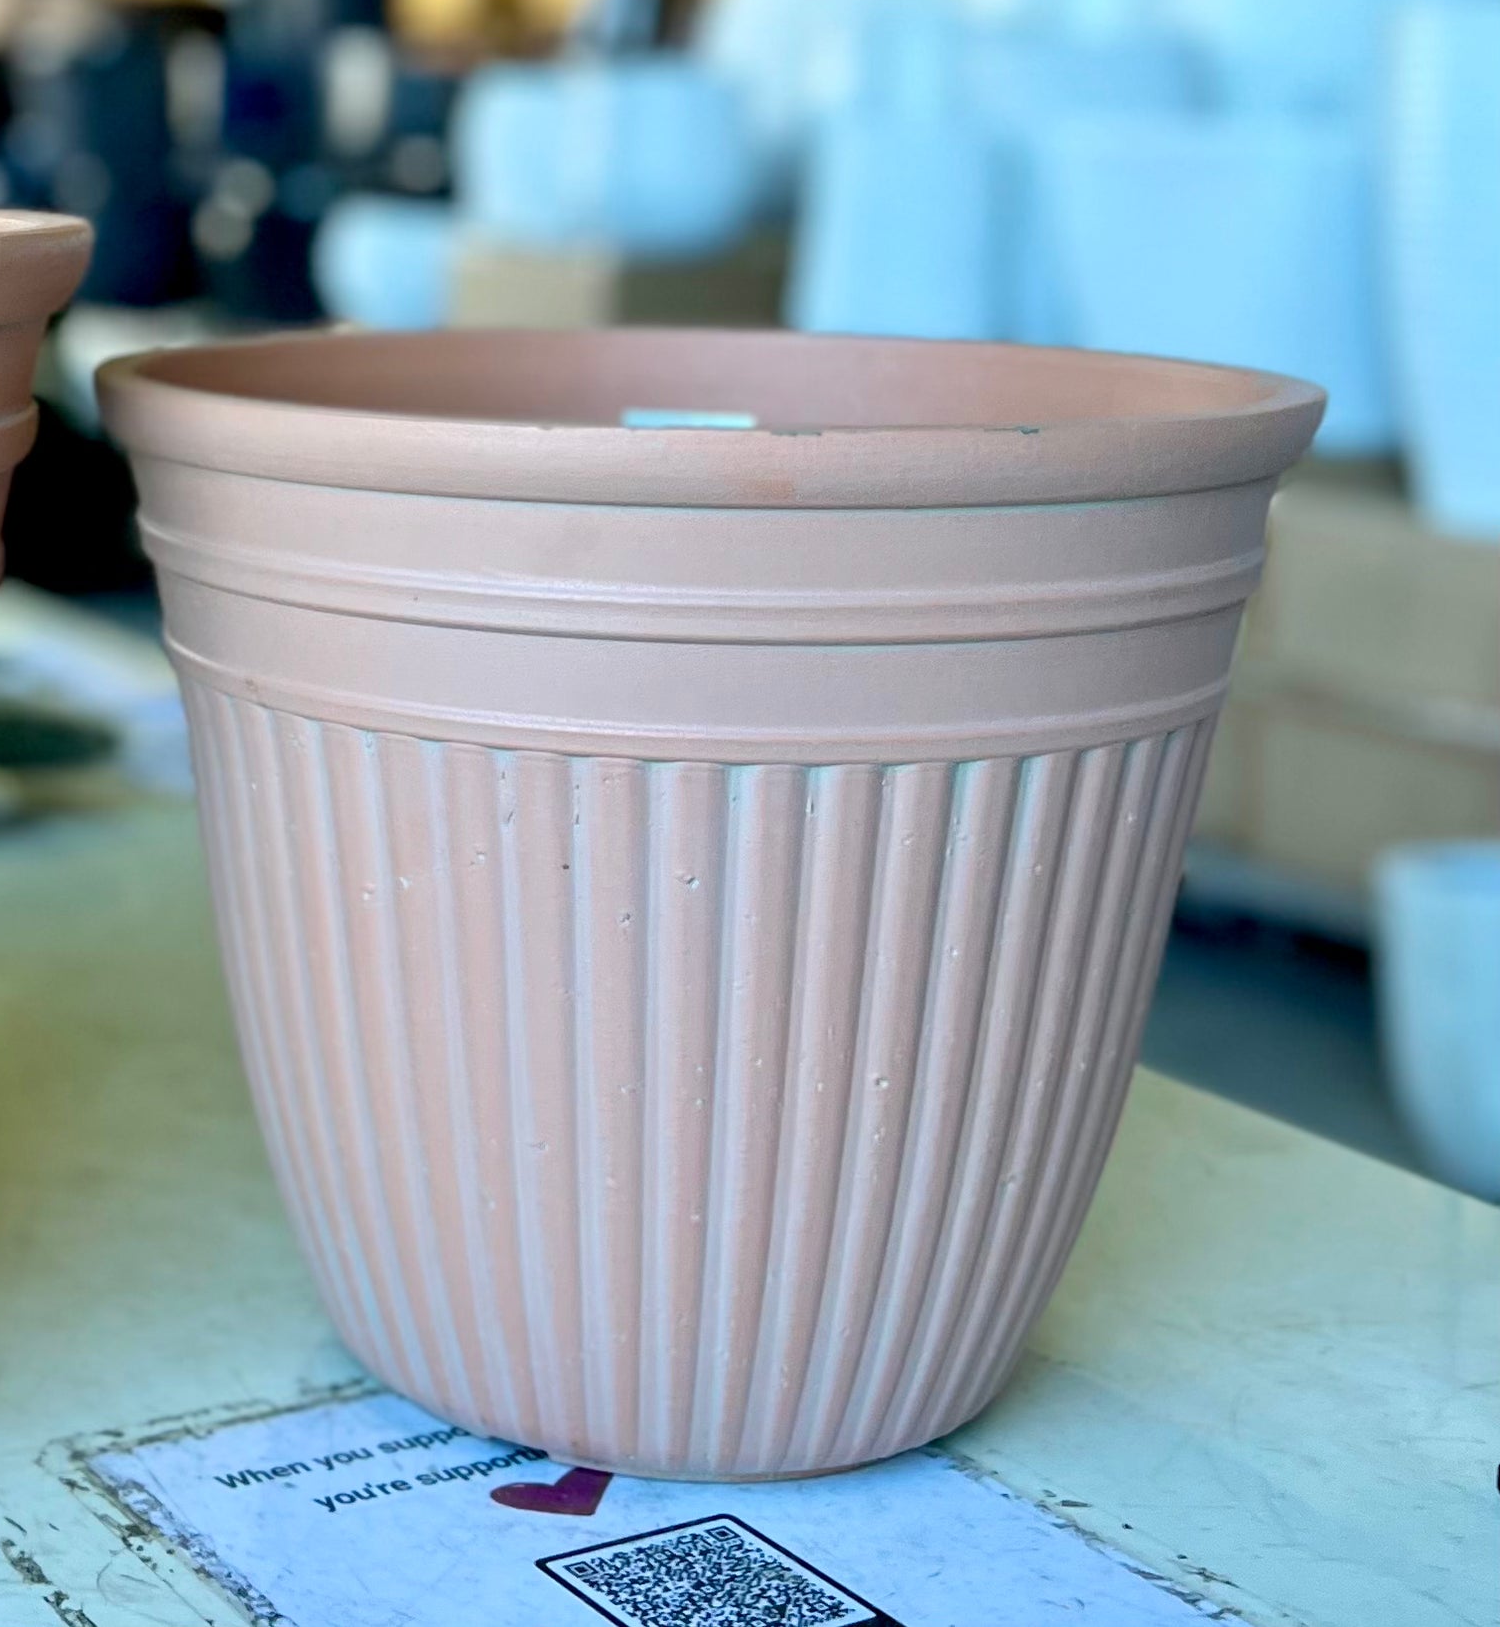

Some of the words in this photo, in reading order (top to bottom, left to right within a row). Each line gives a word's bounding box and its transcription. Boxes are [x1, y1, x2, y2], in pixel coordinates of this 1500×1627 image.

[214, 1459, 311, 1489] When
[312, 1447, 374, 1471] you
[377, 1426, 471, 1454] suppo
[314, 1479, 413, 1513] you're
